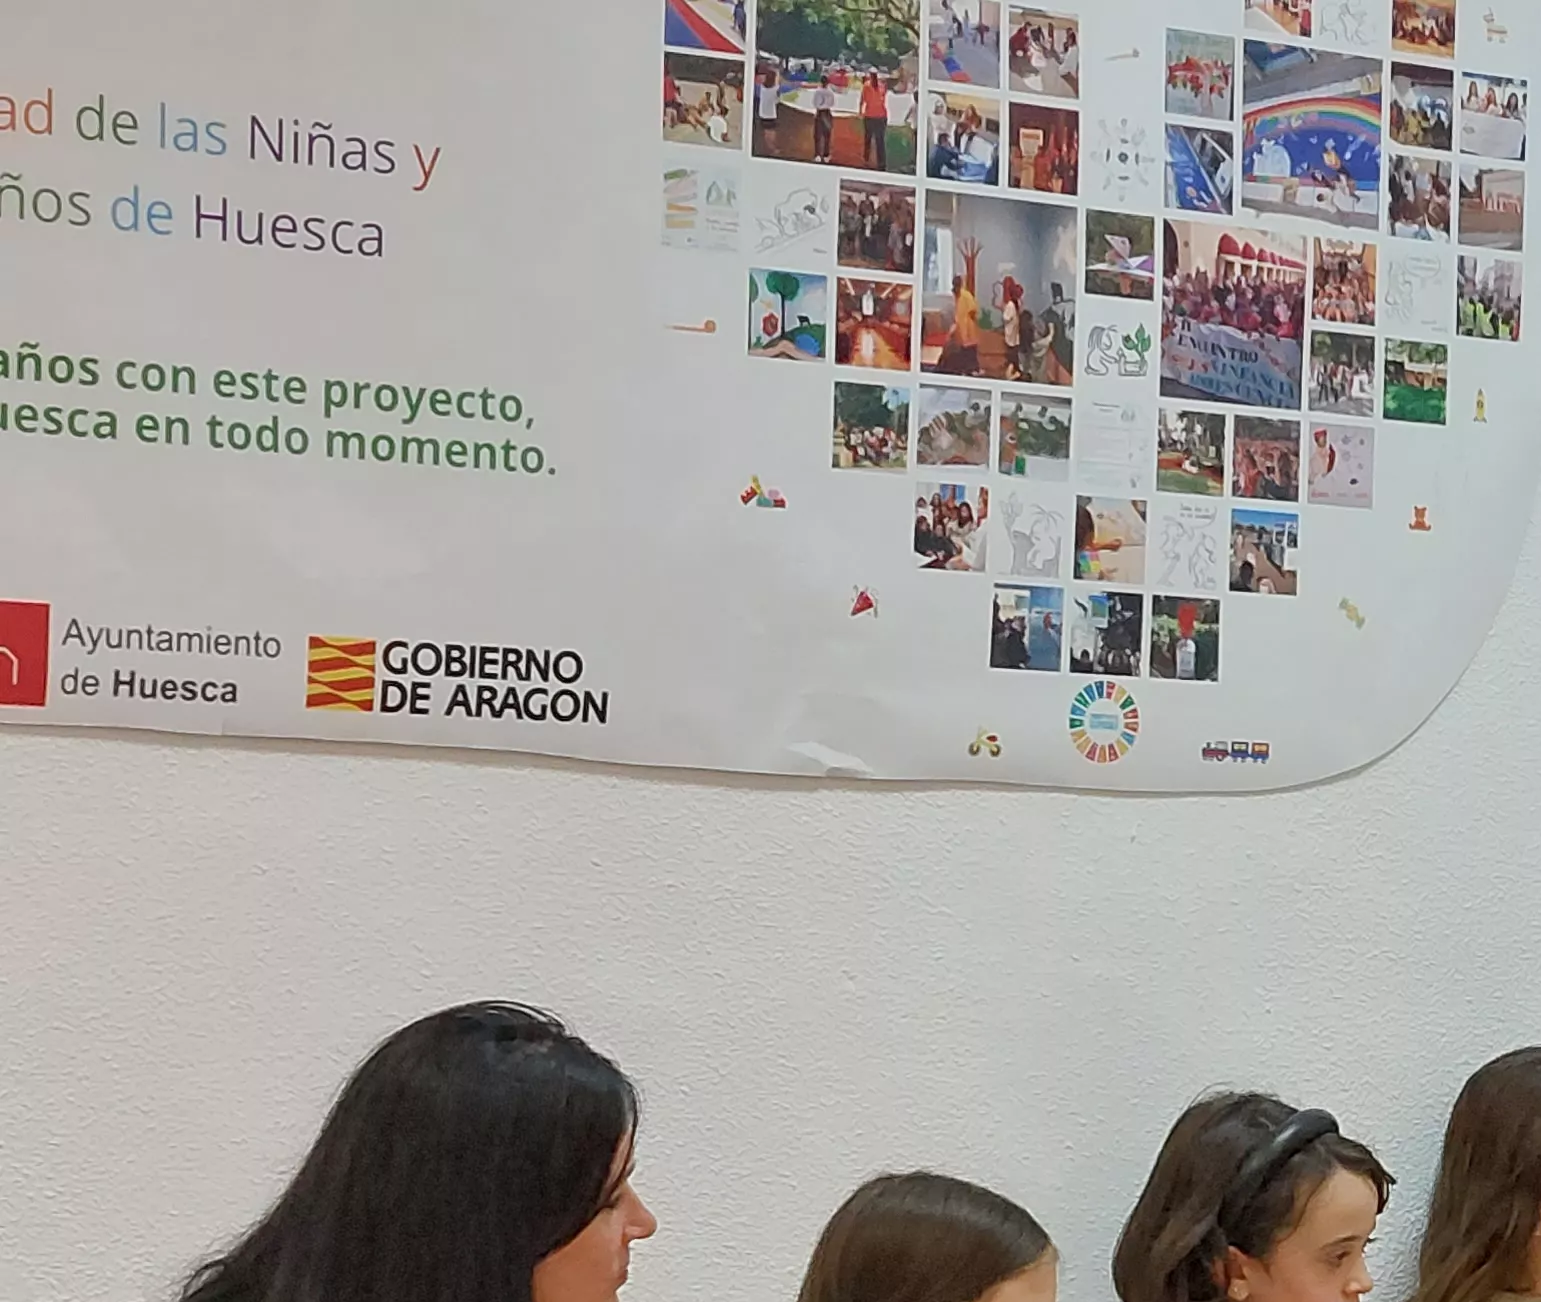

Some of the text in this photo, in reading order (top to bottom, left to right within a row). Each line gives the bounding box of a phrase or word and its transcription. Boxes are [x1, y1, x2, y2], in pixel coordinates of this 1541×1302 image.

[75, 94, 139, 146] de
[157, 103, 227, 157] las
[248, 113, 397, 176] Niñas
[412, 142, 442, 191] y
[110, 185, 173, 237] de
[194, 193, 385, 260] Huesca
[115, 357, 197, 396] con
[212, 366, 307, 405] este
[323, 372, 536, 431] proyecto,
[135, 408, 190, 446] en
[206, 411, 310, 457] todo
[325, 432, 557, 477] momento.
[61, 617, 282, 659] Ayuntamiento
[381, 640, 584, 685] GOBIERNO
[60, 668, 238, 705] de Huesca
[380, 680, 610, 724] DE ARAGON
